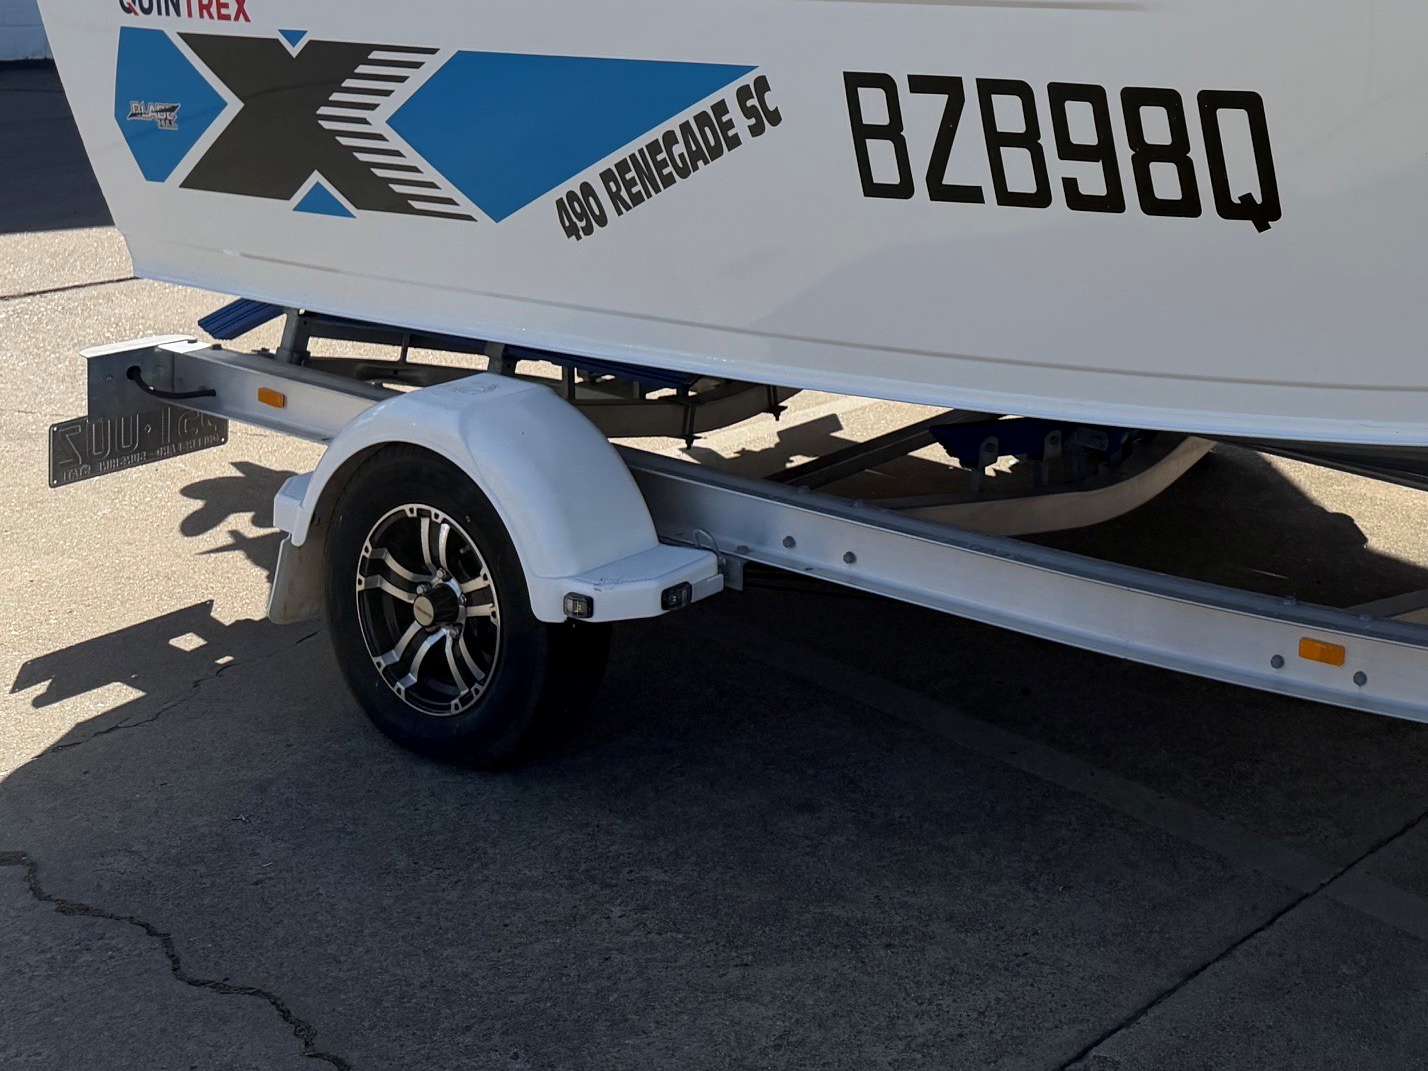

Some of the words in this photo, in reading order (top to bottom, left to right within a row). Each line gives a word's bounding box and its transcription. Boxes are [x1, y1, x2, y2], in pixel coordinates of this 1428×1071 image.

[555, 181, 608, 241] 490
[599, 98, 743, 217] RENEGADE
[736, 74, 783, 138] SC
[842, 71, 1282, 234] BZB98Q
